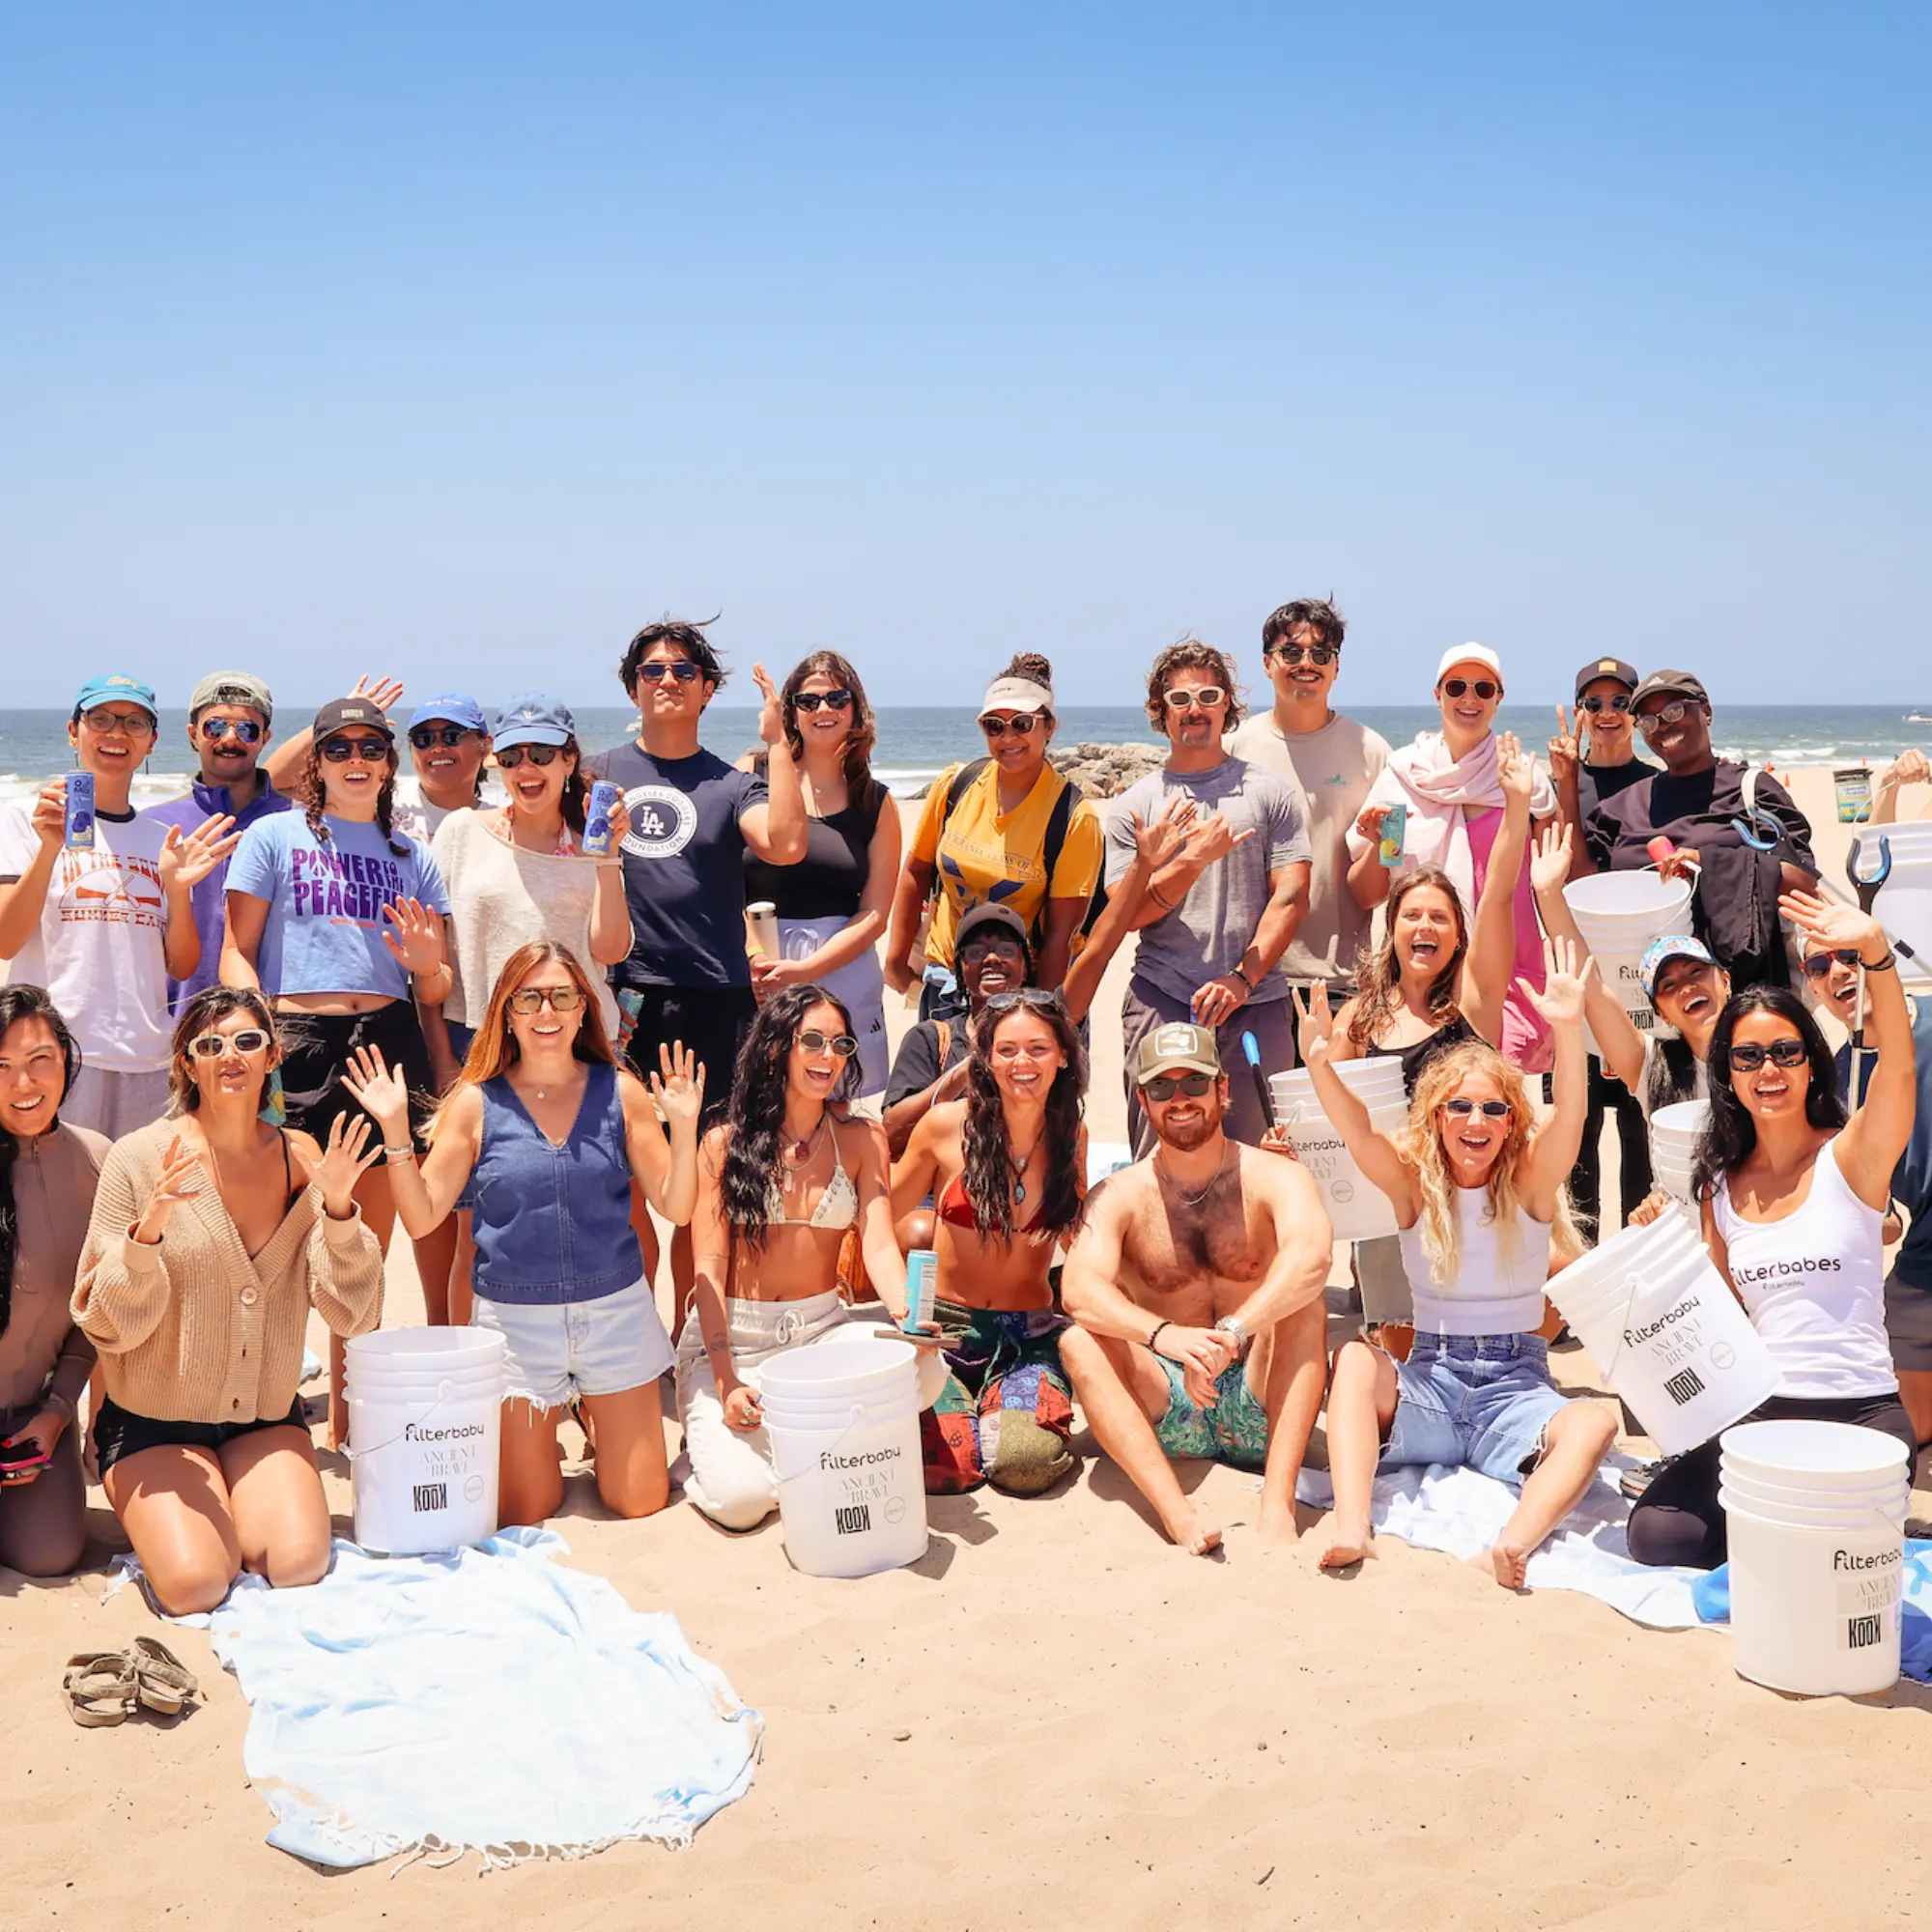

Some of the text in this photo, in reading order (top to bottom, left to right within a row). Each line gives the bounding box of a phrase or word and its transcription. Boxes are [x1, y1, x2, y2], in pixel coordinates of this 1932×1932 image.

[640, 805, 666, 837] LA
[623, 835, 683, 853] OUNDATION
[292, 848, 398, 887] POWER TO
[294, 879, 402, 924] PEACEFU
[1623, 1295, 1701, 1348] filterbaby
[406, 1423, 484, 1441] filterbaby
[820, 1446, 900, 1470] filterbaby
